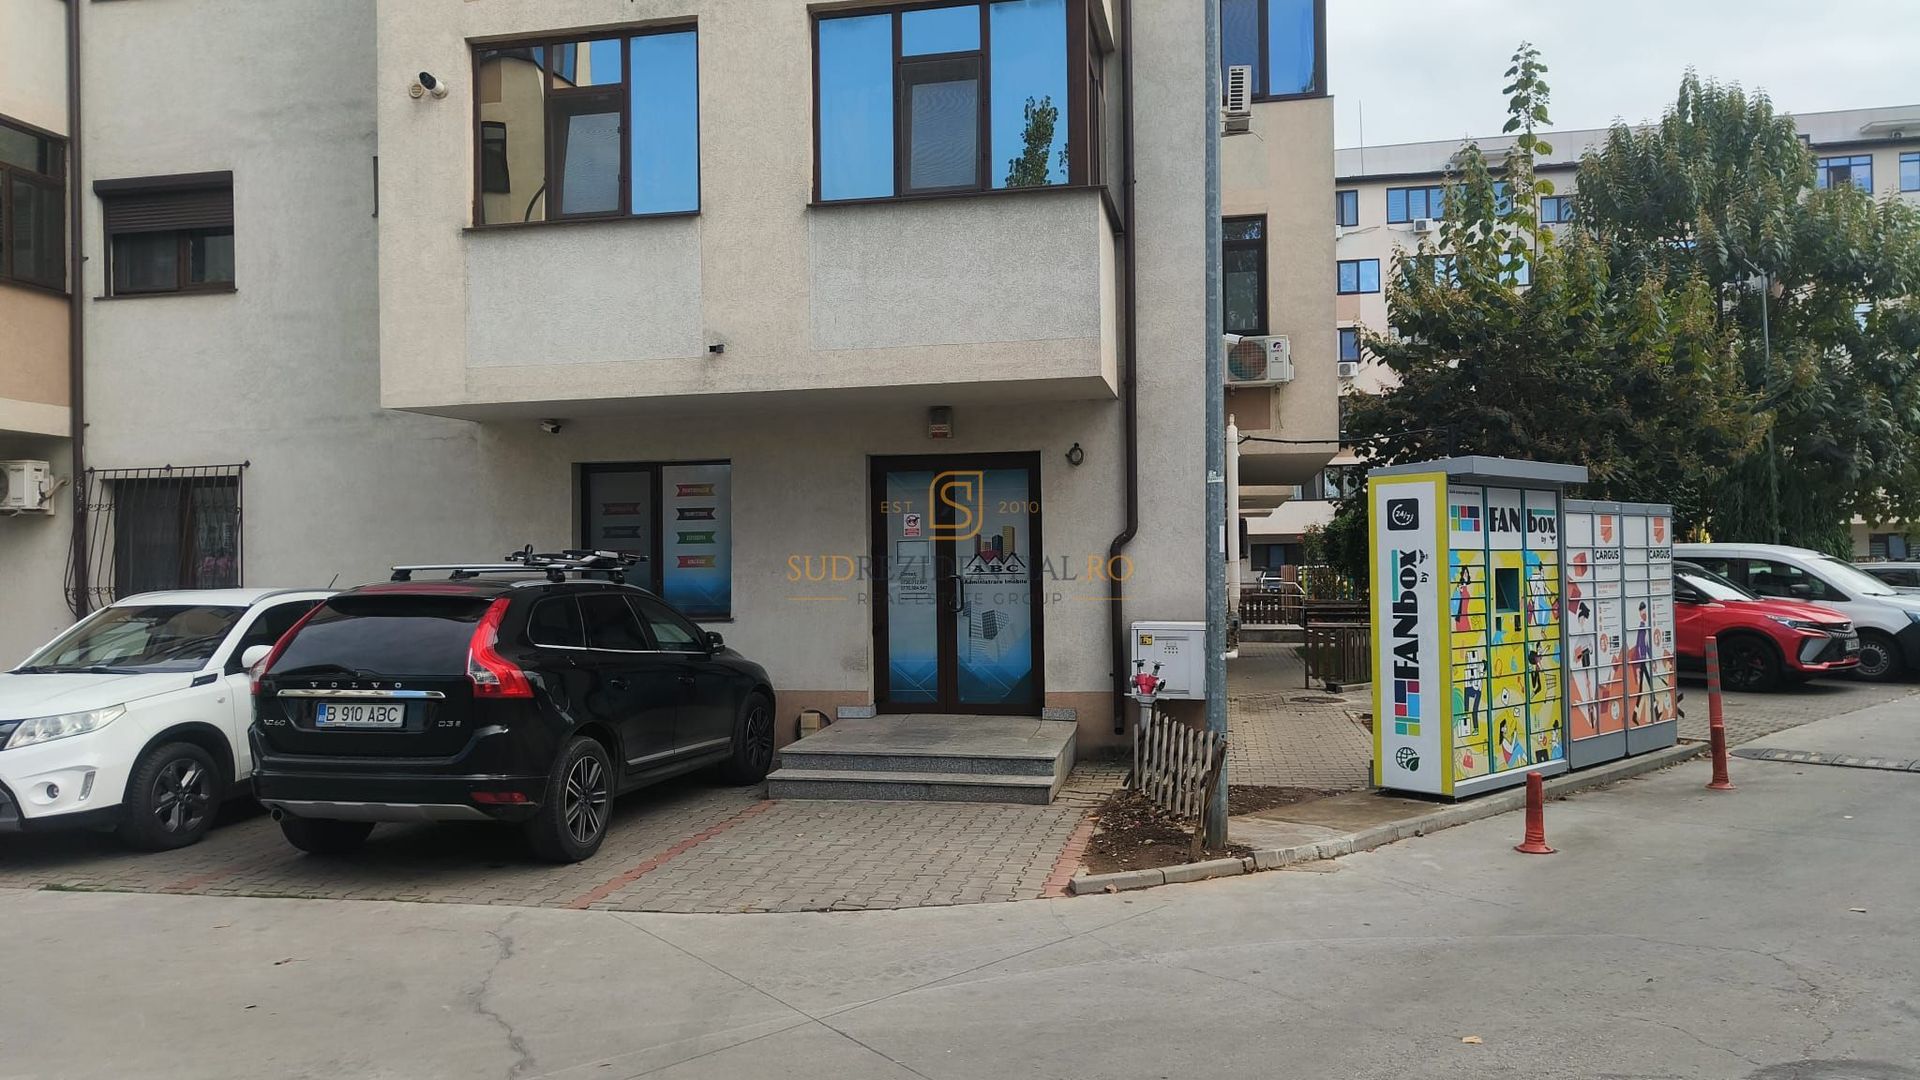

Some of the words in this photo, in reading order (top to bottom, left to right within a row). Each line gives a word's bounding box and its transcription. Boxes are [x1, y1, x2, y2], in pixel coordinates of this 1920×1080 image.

[1395, 510, 1411, 521] 24/7
[1595, 550, 1620, 560] CARGUS
[1649, 549, 1671, 560] CARGUS
[972, 564, 1019, 573] ABC
[1393, 549, 1419, 680] FANbox
[310, 681, 402, 689] VOLVO
[326, 706, 337, 722] B
[341, 707, 363, 722] 910
[367, 707, 399, 723] ABC
